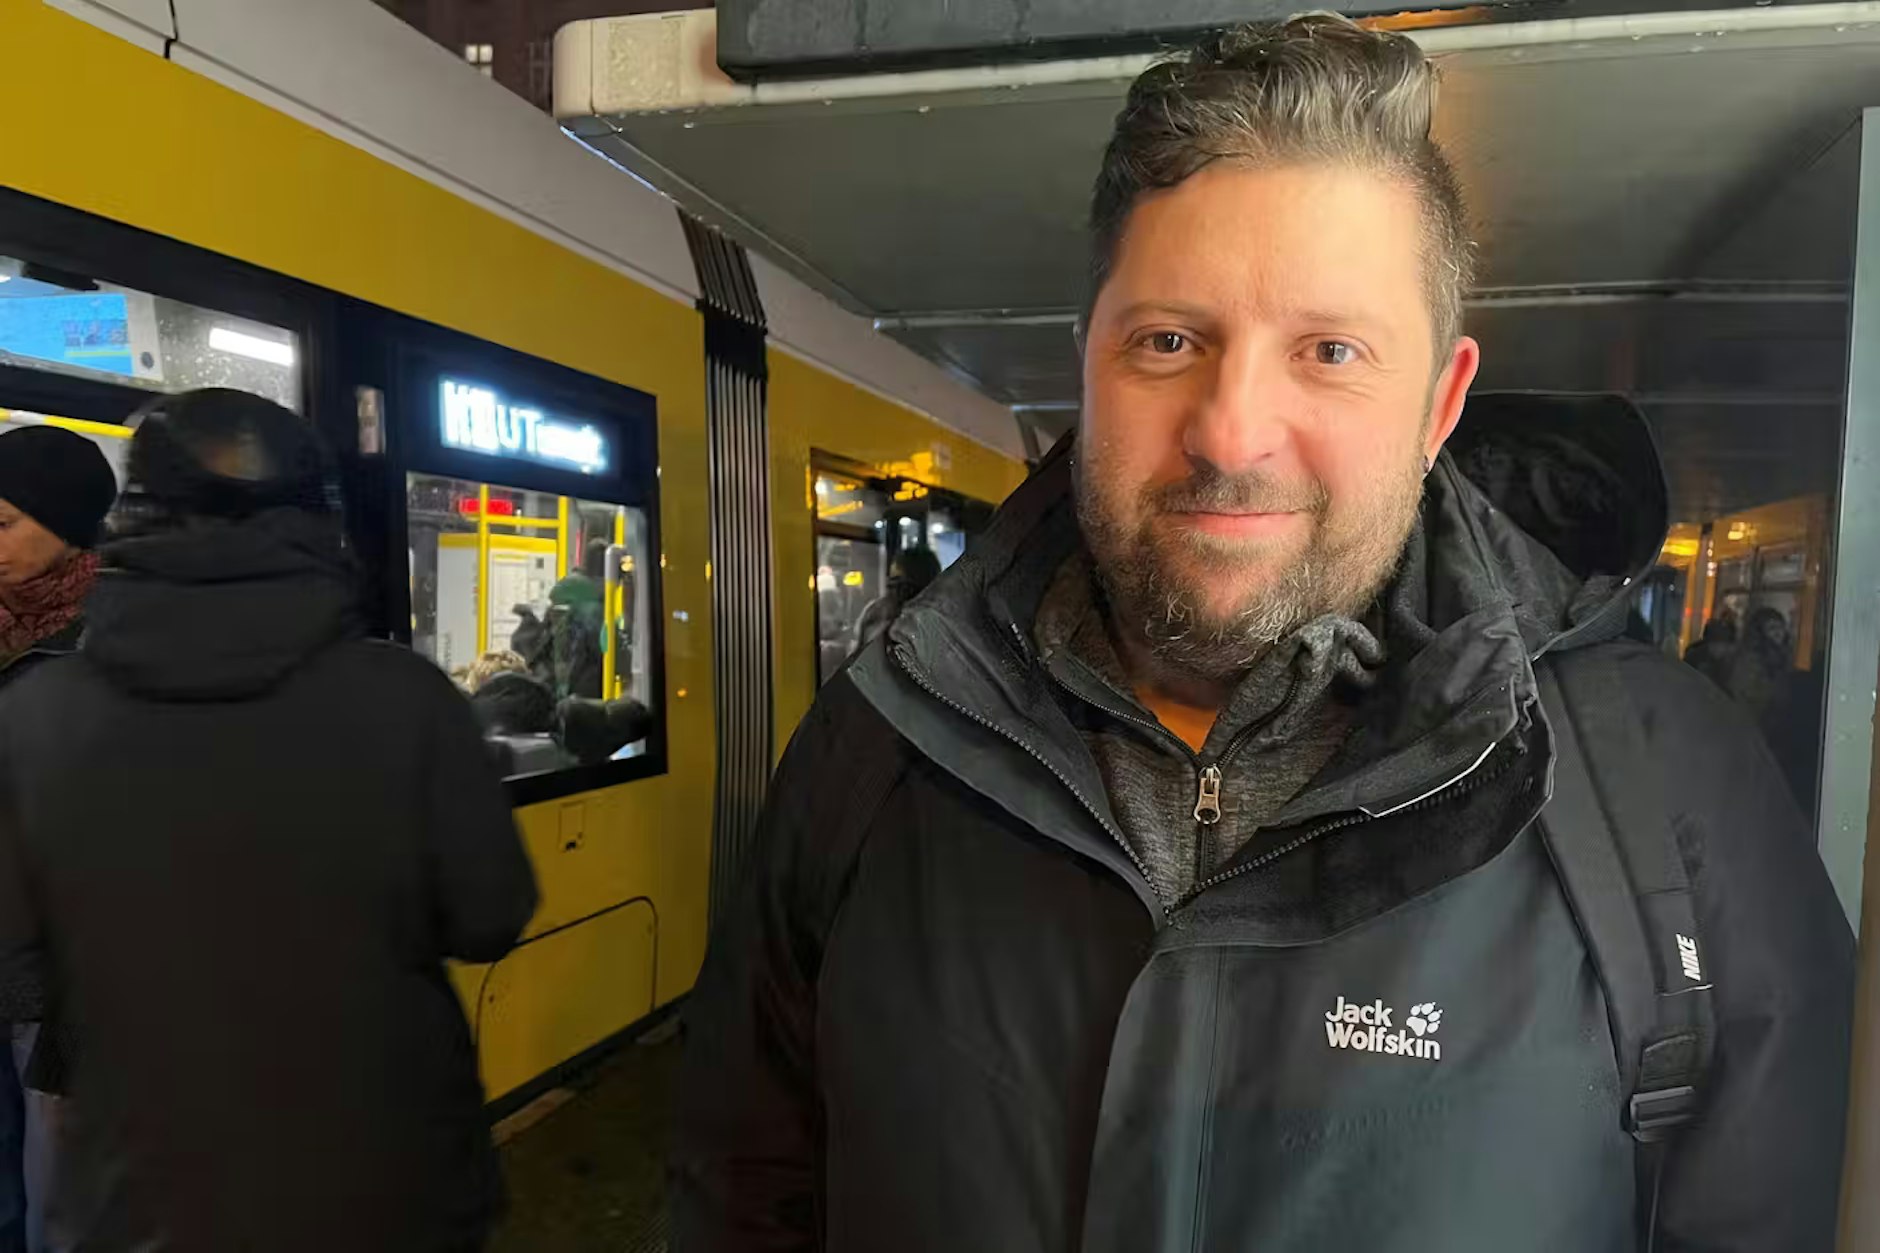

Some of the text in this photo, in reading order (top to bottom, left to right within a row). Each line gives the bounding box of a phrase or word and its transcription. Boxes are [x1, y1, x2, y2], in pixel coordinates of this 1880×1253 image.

[1675, 933, 1701, 981] NIKE
[1325, 996, 1393, 1027] Jack
[1325, 1021, 1441, 1060] Wolfskin
